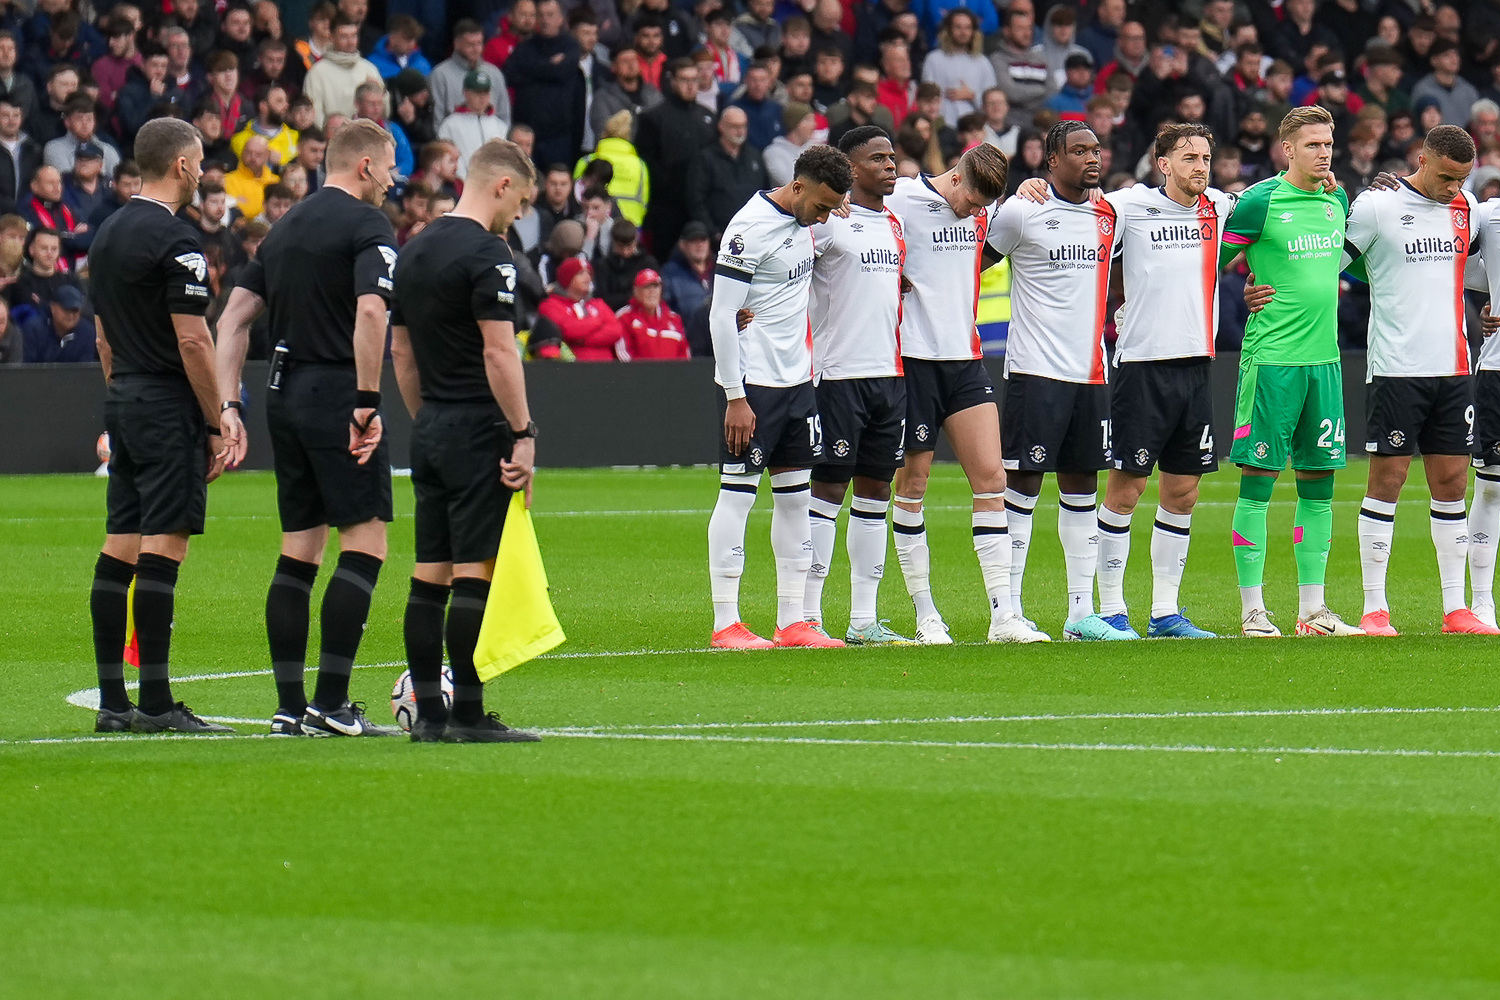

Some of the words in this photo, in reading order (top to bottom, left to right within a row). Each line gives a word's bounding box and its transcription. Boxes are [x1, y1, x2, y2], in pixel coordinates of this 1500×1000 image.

[932, 227, 975, 244] utilita
[1150, 226, 1200, 242] utilita
[1287, 233, 1332, 253] utilita
[1049, 245, 1096, 262] utilita
[1288, 252, 1299, 261] life
[1300, 250, 1314, 258] with
[1315, 249, 1333, 259] power
[1405, 237, 1453, 255] utilita
[860, 248, 899, 265] utilita
[1464, 404, 1475, 434] 9
[806, 413, 823, 446] 19
[1199, 424, 1214, 453] 4
[1317, 418, 1345, 448] 24
